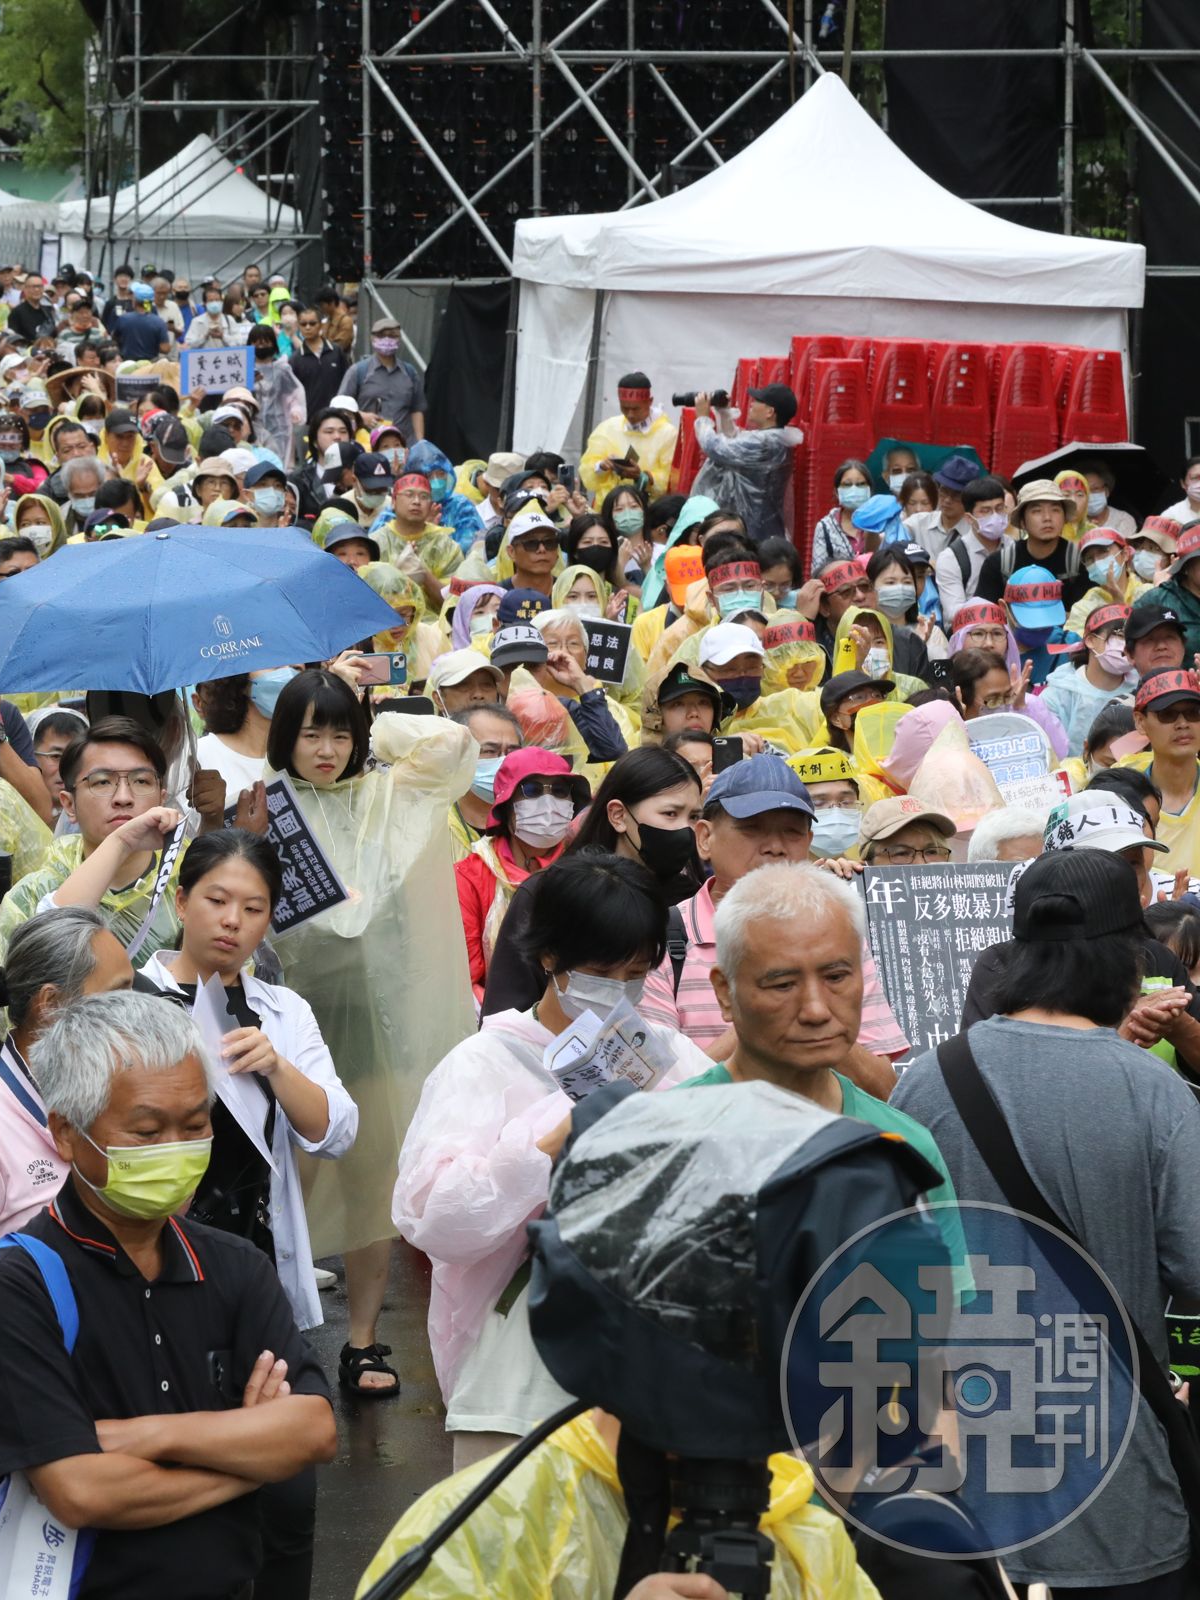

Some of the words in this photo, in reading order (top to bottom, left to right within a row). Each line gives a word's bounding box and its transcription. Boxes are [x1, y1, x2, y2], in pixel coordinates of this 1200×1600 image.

[591, 633, 619, 649] 惡法
[866, 877, 907, 915] 年
[914, 892, 1009, 921] 反多數暴力
